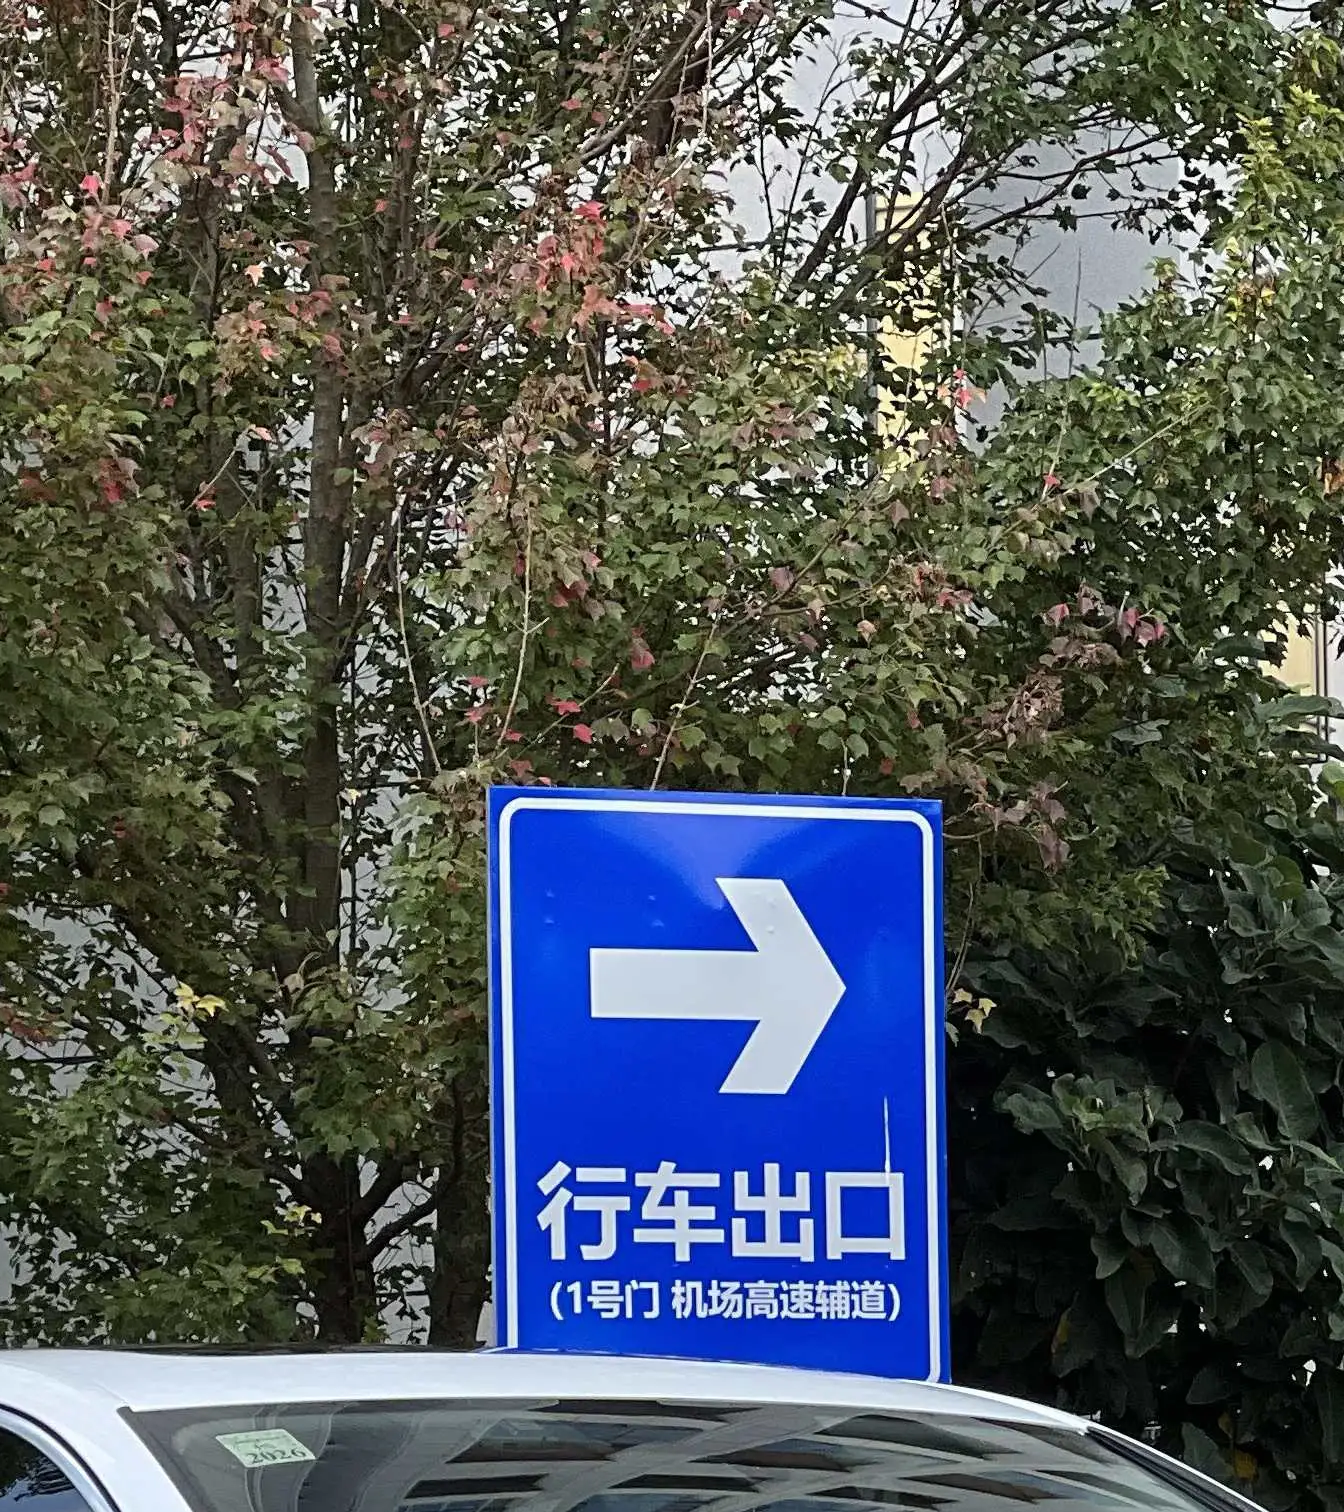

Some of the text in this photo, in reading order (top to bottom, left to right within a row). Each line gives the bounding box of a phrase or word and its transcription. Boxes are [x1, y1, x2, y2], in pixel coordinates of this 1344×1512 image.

[536, 1160, 906, 1263] 行车出口
[549, 1279, 901, 1322] (1号门 机场高速辅道)
